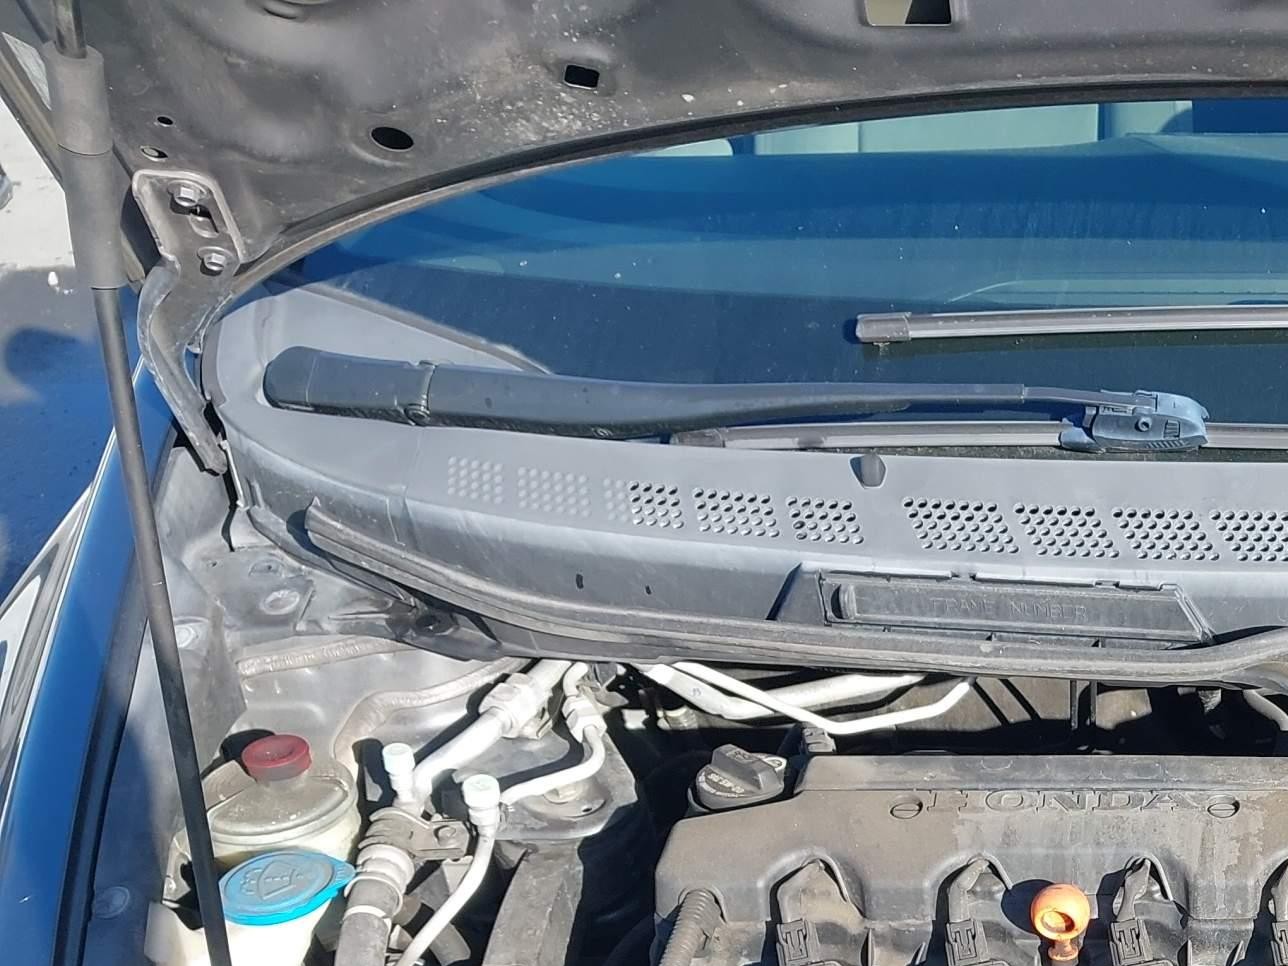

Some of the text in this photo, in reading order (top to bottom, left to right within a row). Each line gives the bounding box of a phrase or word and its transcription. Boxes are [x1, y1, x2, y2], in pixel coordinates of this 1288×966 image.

[931, 598, 1089, 619] FRAME NUMBER
[927, 789, 1200, 813] HONDA
